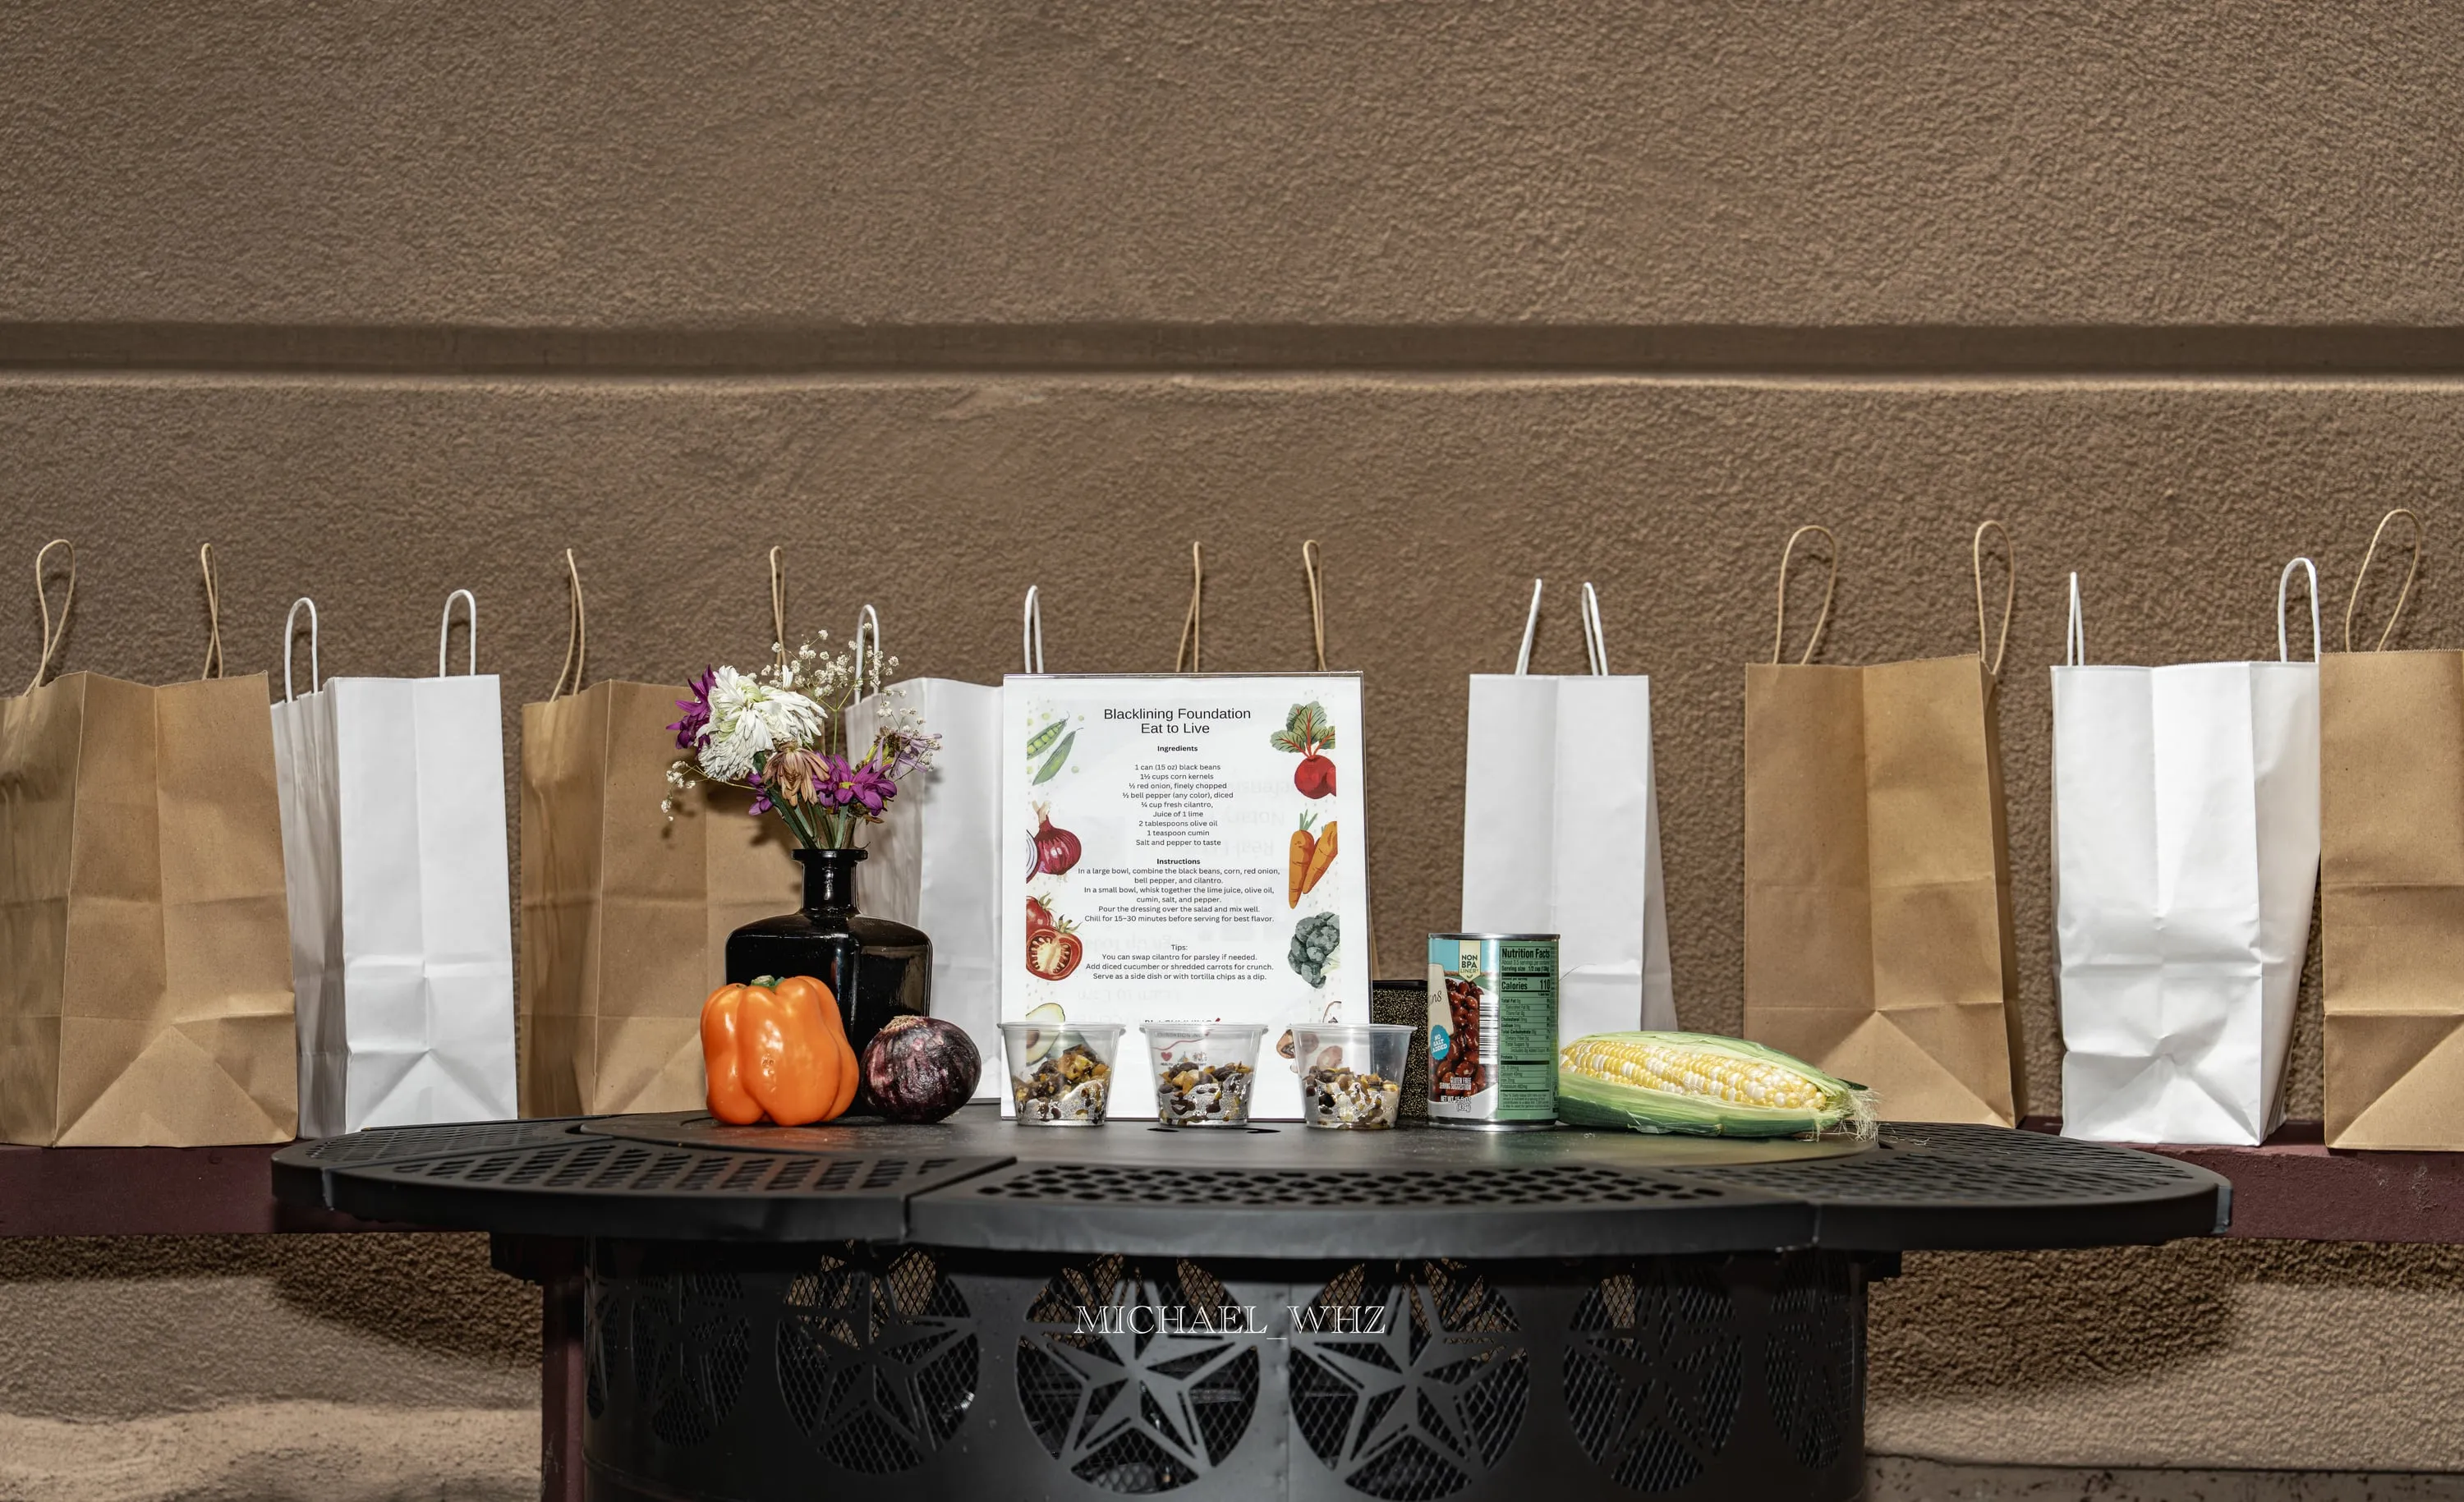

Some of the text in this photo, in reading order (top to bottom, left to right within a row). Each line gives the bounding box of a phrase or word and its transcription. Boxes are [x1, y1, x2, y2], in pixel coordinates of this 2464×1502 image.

[1104, 708, 1251, 722] Blacklining Foundation
[1141, 722, 1210, 734] Eat to Live
[1157, 745, 1198, 753] Ingredients
[1174, 783, 1194, 791] finely
[1161, 887, 1192, 895] together
[1223, 887, 1243, 895] juice,
[1130, 906, 1161, 914] dressing
[1193, 953, 1221, 962] parsley
[1501, 948, 1551, 959] Nutrition Facts
[1216, 973, 1236, 981] chips
[1501, 979, 1551, 990] Calories 110
[1432, 1039, 1445, 1047] SALT
[1432, 1045, 1448, 1053] ADDED
